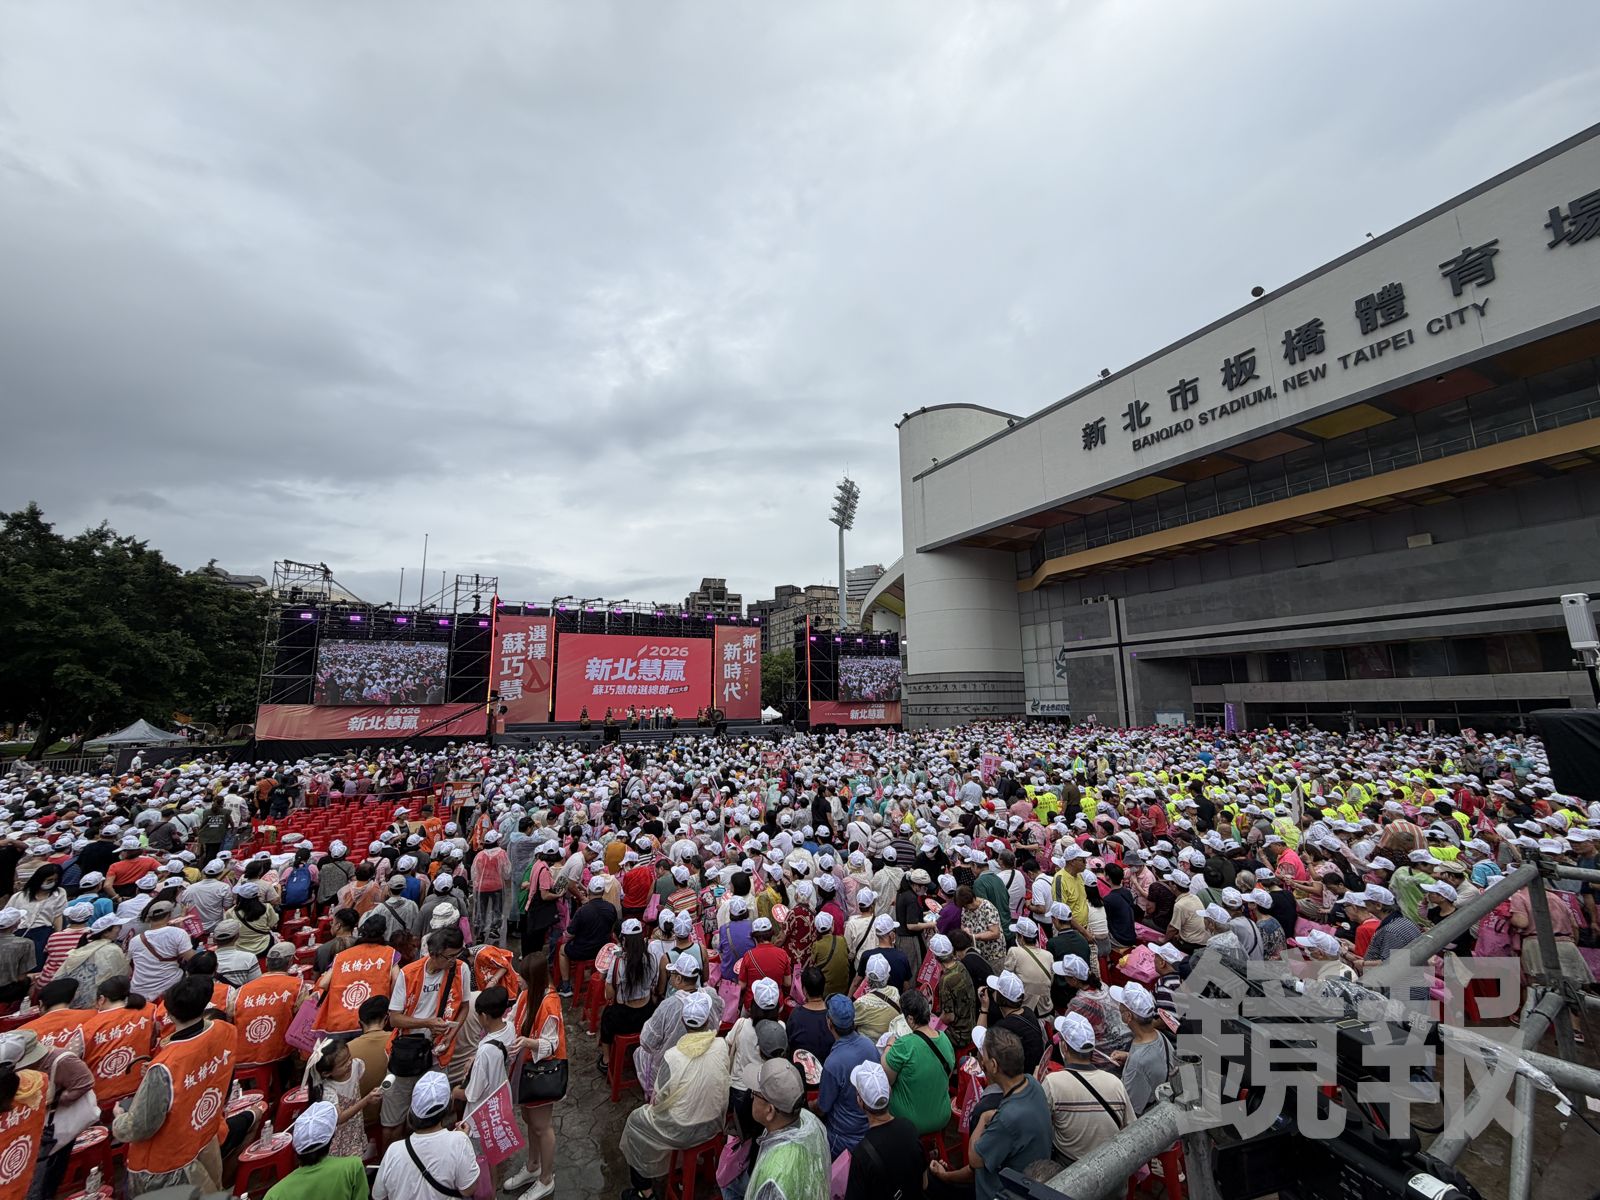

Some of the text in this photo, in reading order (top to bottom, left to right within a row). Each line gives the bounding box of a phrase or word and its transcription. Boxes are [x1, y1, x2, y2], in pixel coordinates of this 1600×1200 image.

[1082, 188, 1600, 451] 新北市板橋體育場
[1132, 417, 1194, 453] BANQIAO
[1282, 363, 1327, 392] NEW
[1337, 329, 1415, 371] TAIPEI
[1426, 297, 1491, 336] CITY
[527, 624, 547, 661] 選擇
[648, 646, 689, 657] 2026
[742, 634, 757, 665] 新北
[498, 632, 527, 701] 蘇巧慧
[584, 657, 687, 682] 新北慧贏
[723, 642, 742, 702] 新時代
[347, 715, 420, 732] 新北慧贏
[392, 707, 421, 715] 2026
[340, 956, 386, 974] 板橋分會
[243, 989, 292, 1008] 板橋分會
[94, 1016, 149, 1044] 板橋分會
[183, 1049, 232, 1090] 板橋分會
[504, 1125, 520, 1146] 2026
